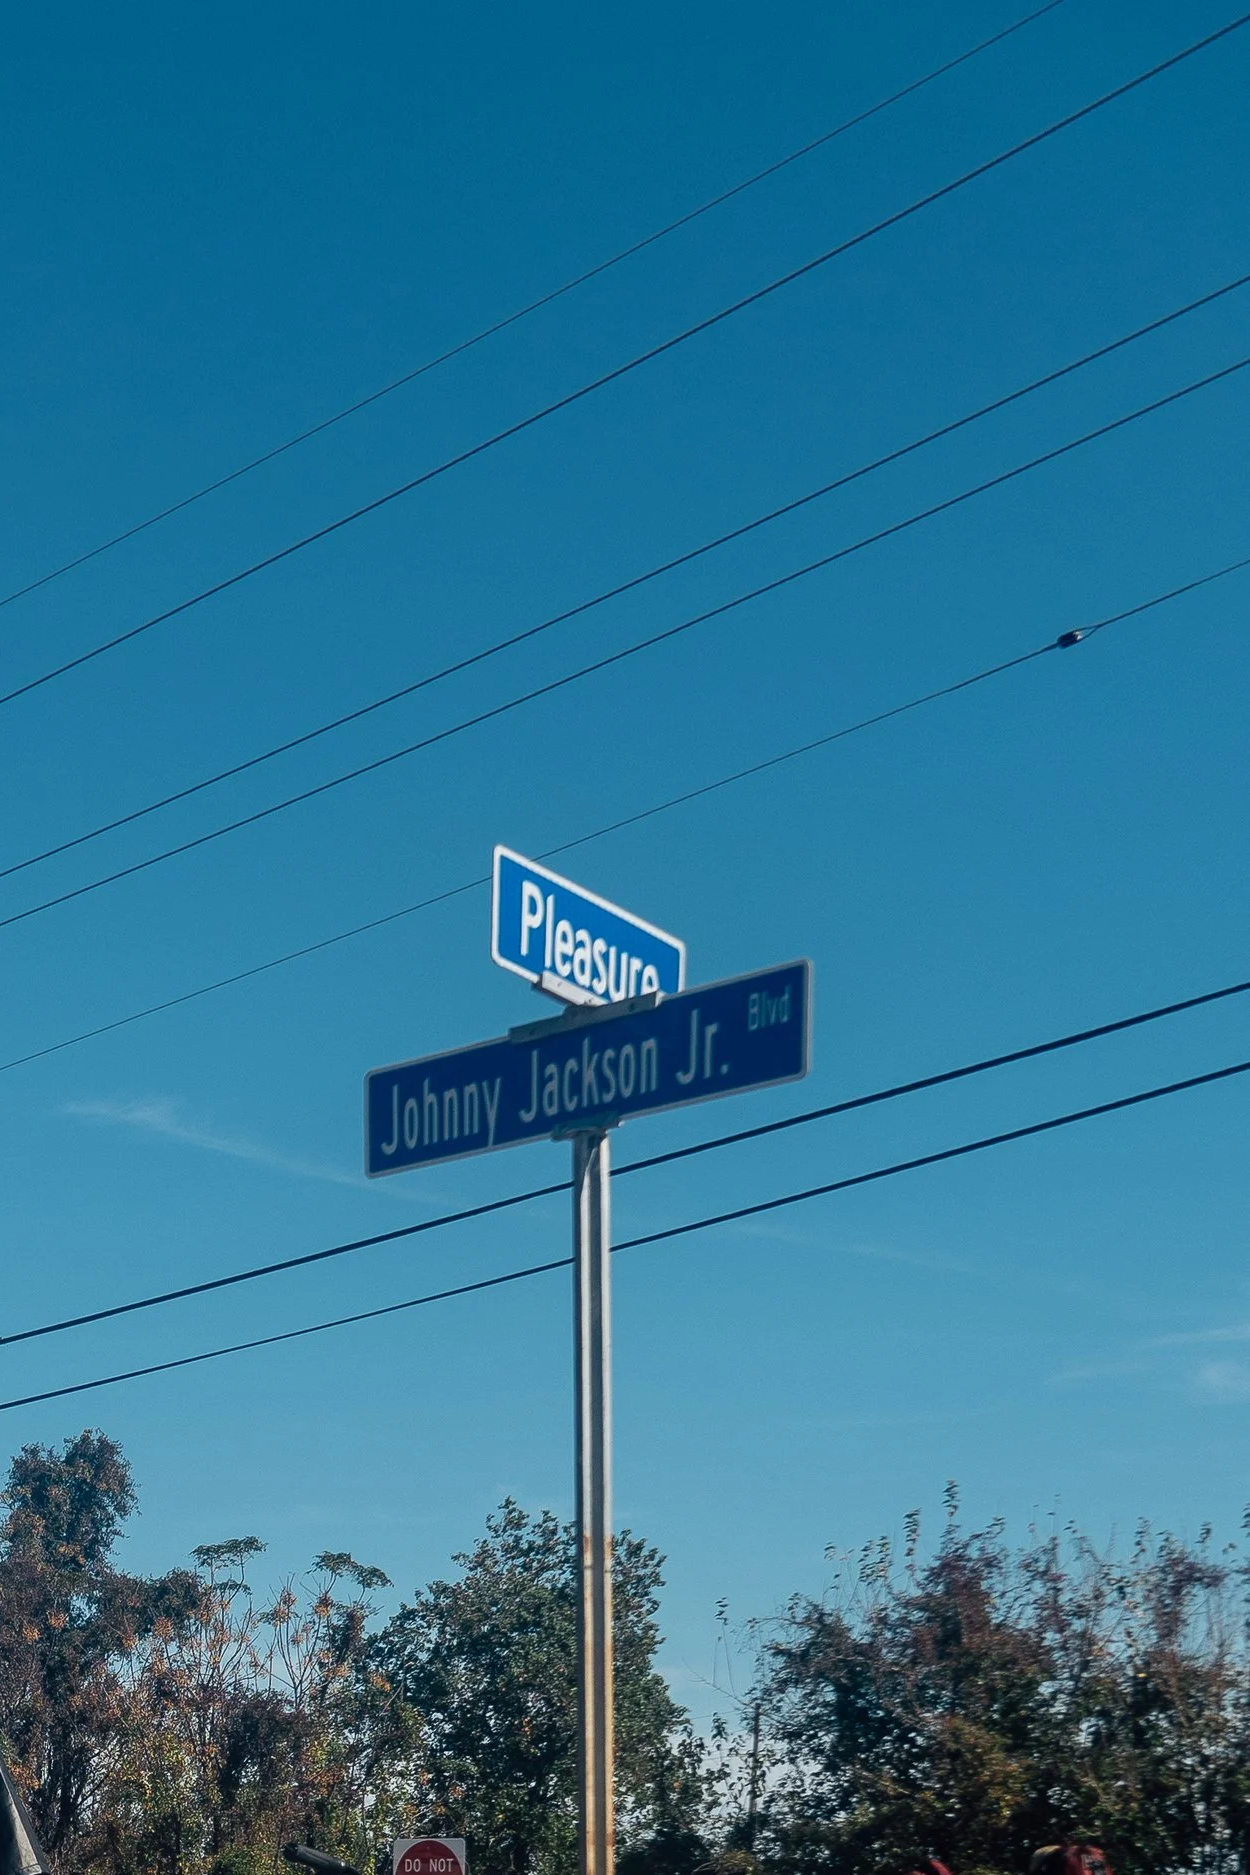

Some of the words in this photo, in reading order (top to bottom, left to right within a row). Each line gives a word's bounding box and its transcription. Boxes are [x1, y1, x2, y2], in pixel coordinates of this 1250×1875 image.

[520, 880, 659, 1003] Pleasure
[381, 1076, 502, 1155] Johnny
[519, 1036, 658, 1123] Jackson
[676, 1009, 730, 1085] Jr.
[749, 985, 790, 1031] Blvd
[405, 1858, 421, 1873] DO
[430, 1858, 454, 1873] NOT
